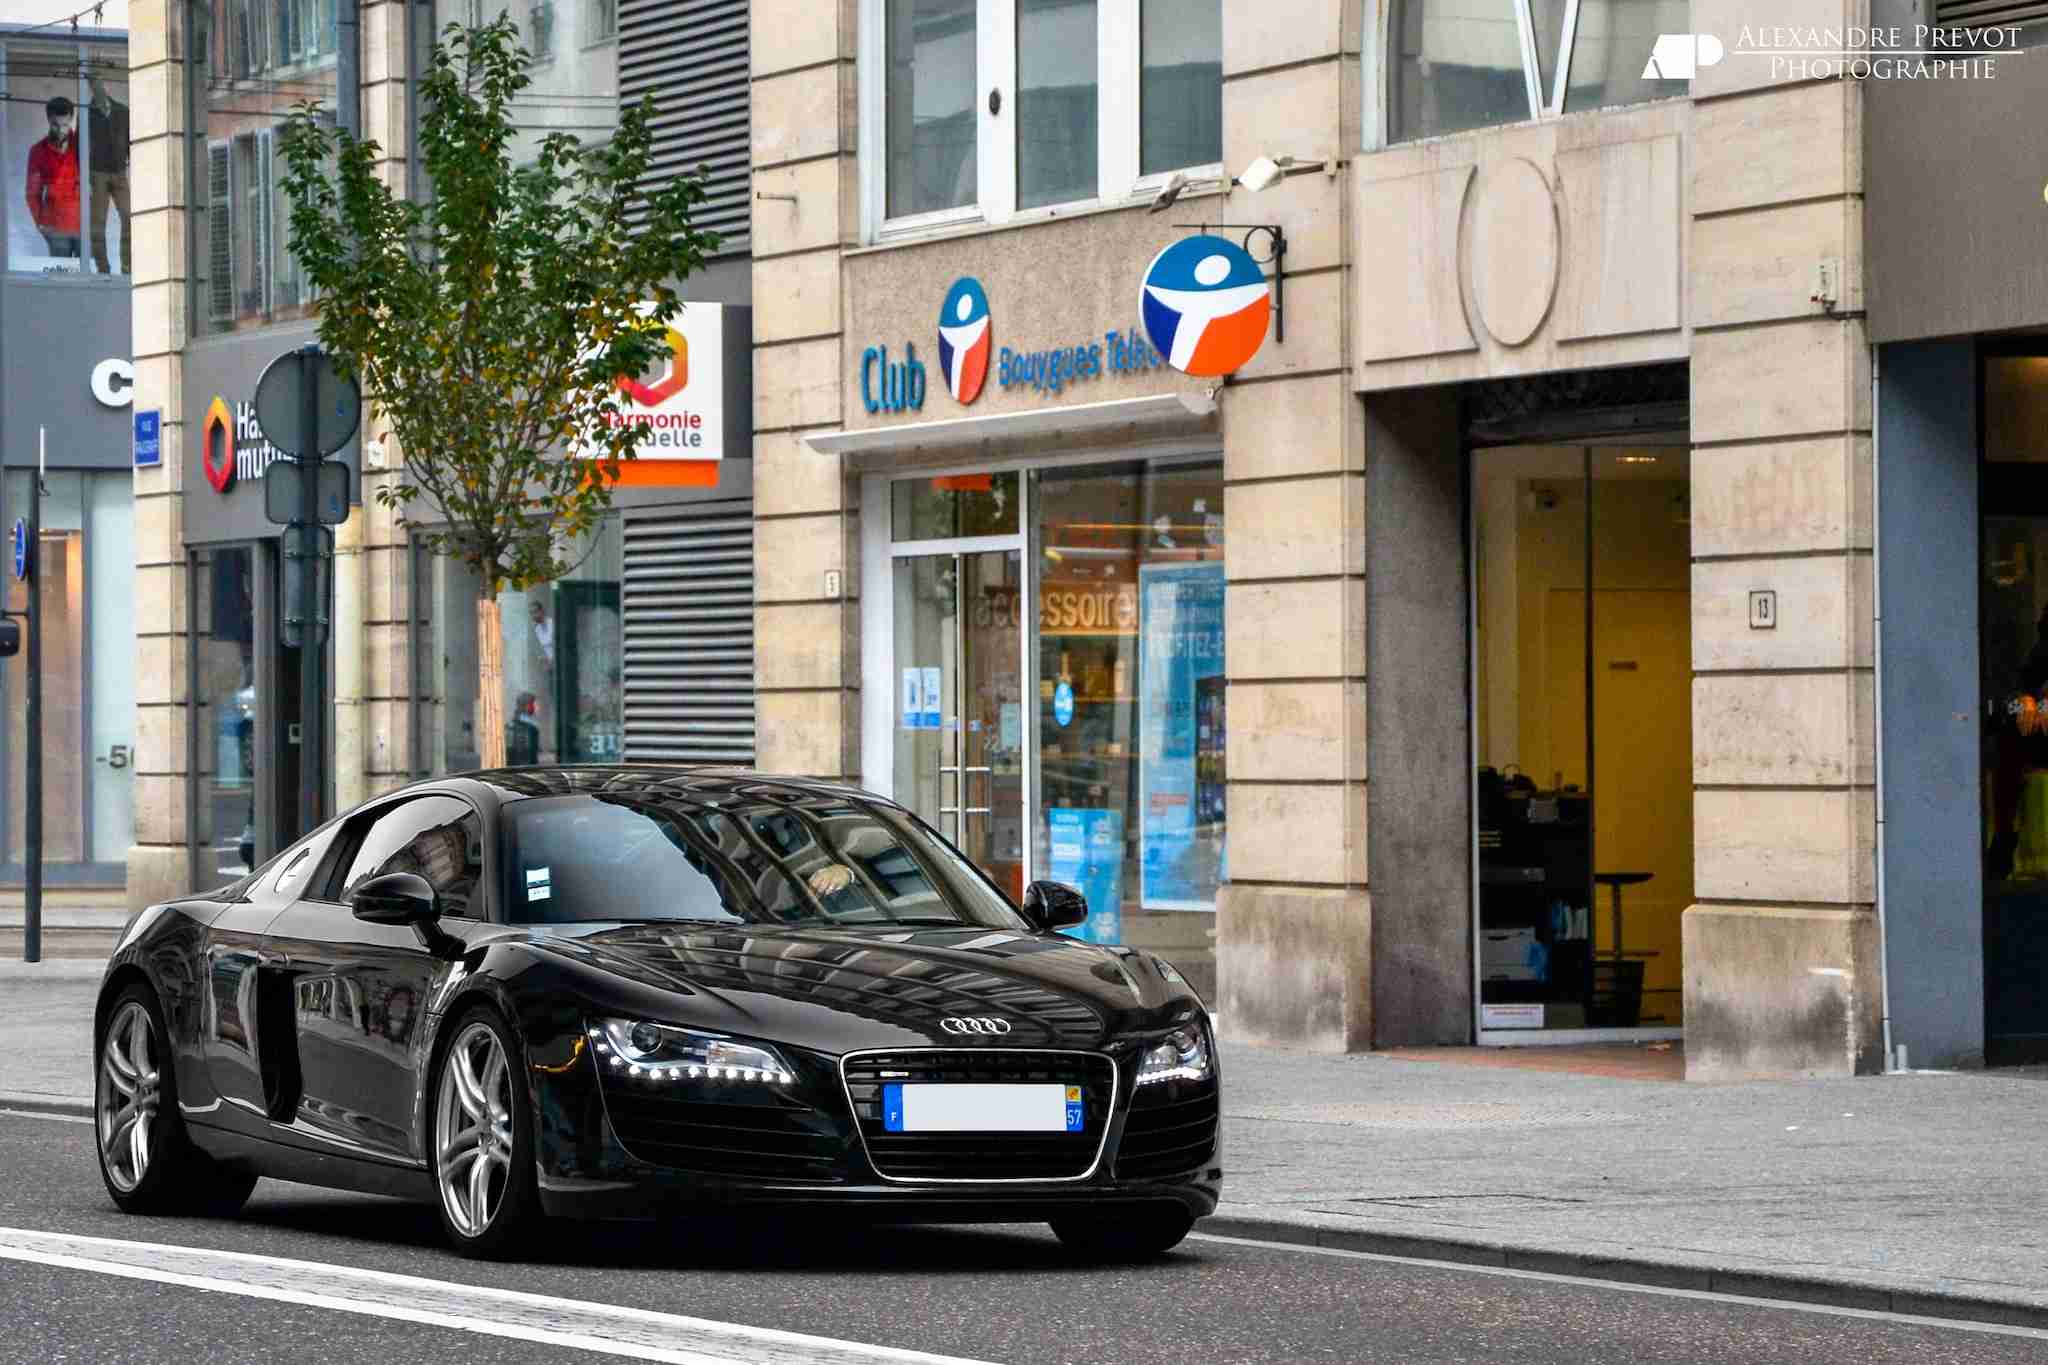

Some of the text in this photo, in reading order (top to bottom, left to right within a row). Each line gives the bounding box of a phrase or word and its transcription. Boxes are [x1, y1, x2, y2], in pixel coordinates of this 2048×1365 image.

[860, 342, 925, 413] Club
[998, 343, 1099, 390] Bouygues
[1758, 598, 1768, 618] 13
[891, 1112, 897, 1121] F
[1067, 1109, 1081, 1125] 57
